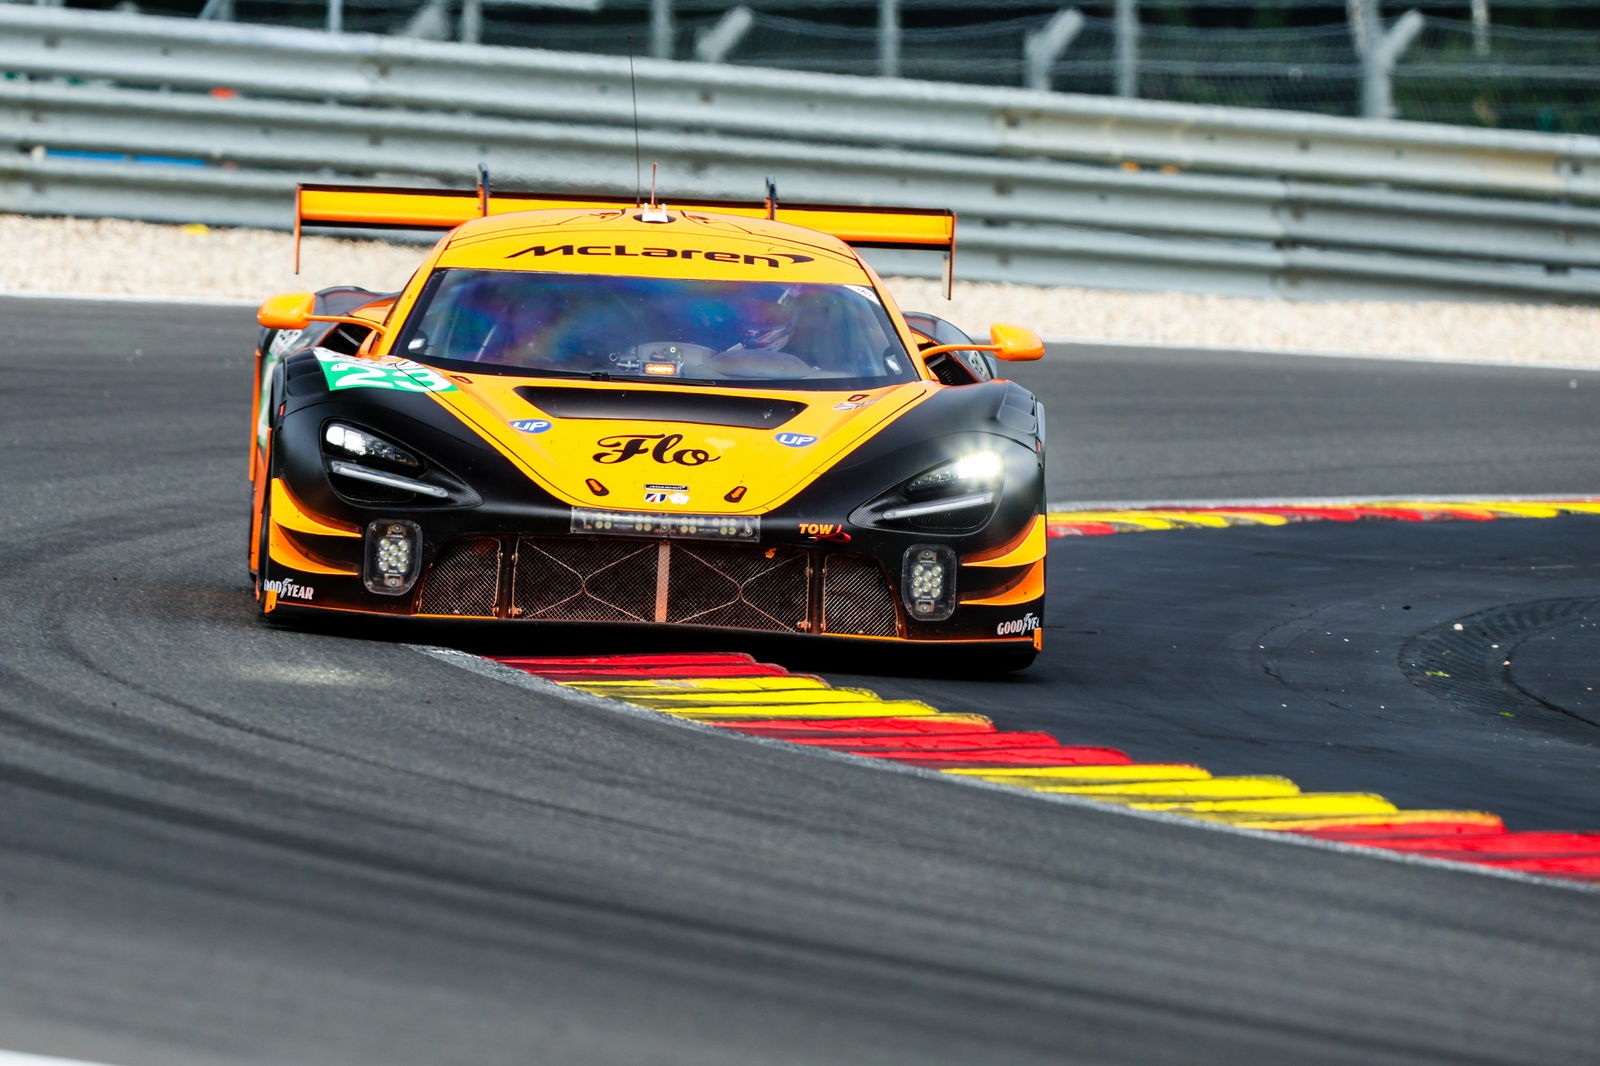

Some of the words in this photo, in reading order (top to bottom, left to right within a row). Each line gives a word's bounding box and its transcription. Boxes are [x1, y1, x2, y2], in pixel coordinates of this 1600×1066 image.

[504, 244, 780, 268] McLaren
[330, 362, 453, 391] 23
[513, 421, 549, 431] UP
[780, 434, 815, 445] UP
[592, 433, 721, 466] Flo
[799, 524, 834, 535] TOW
